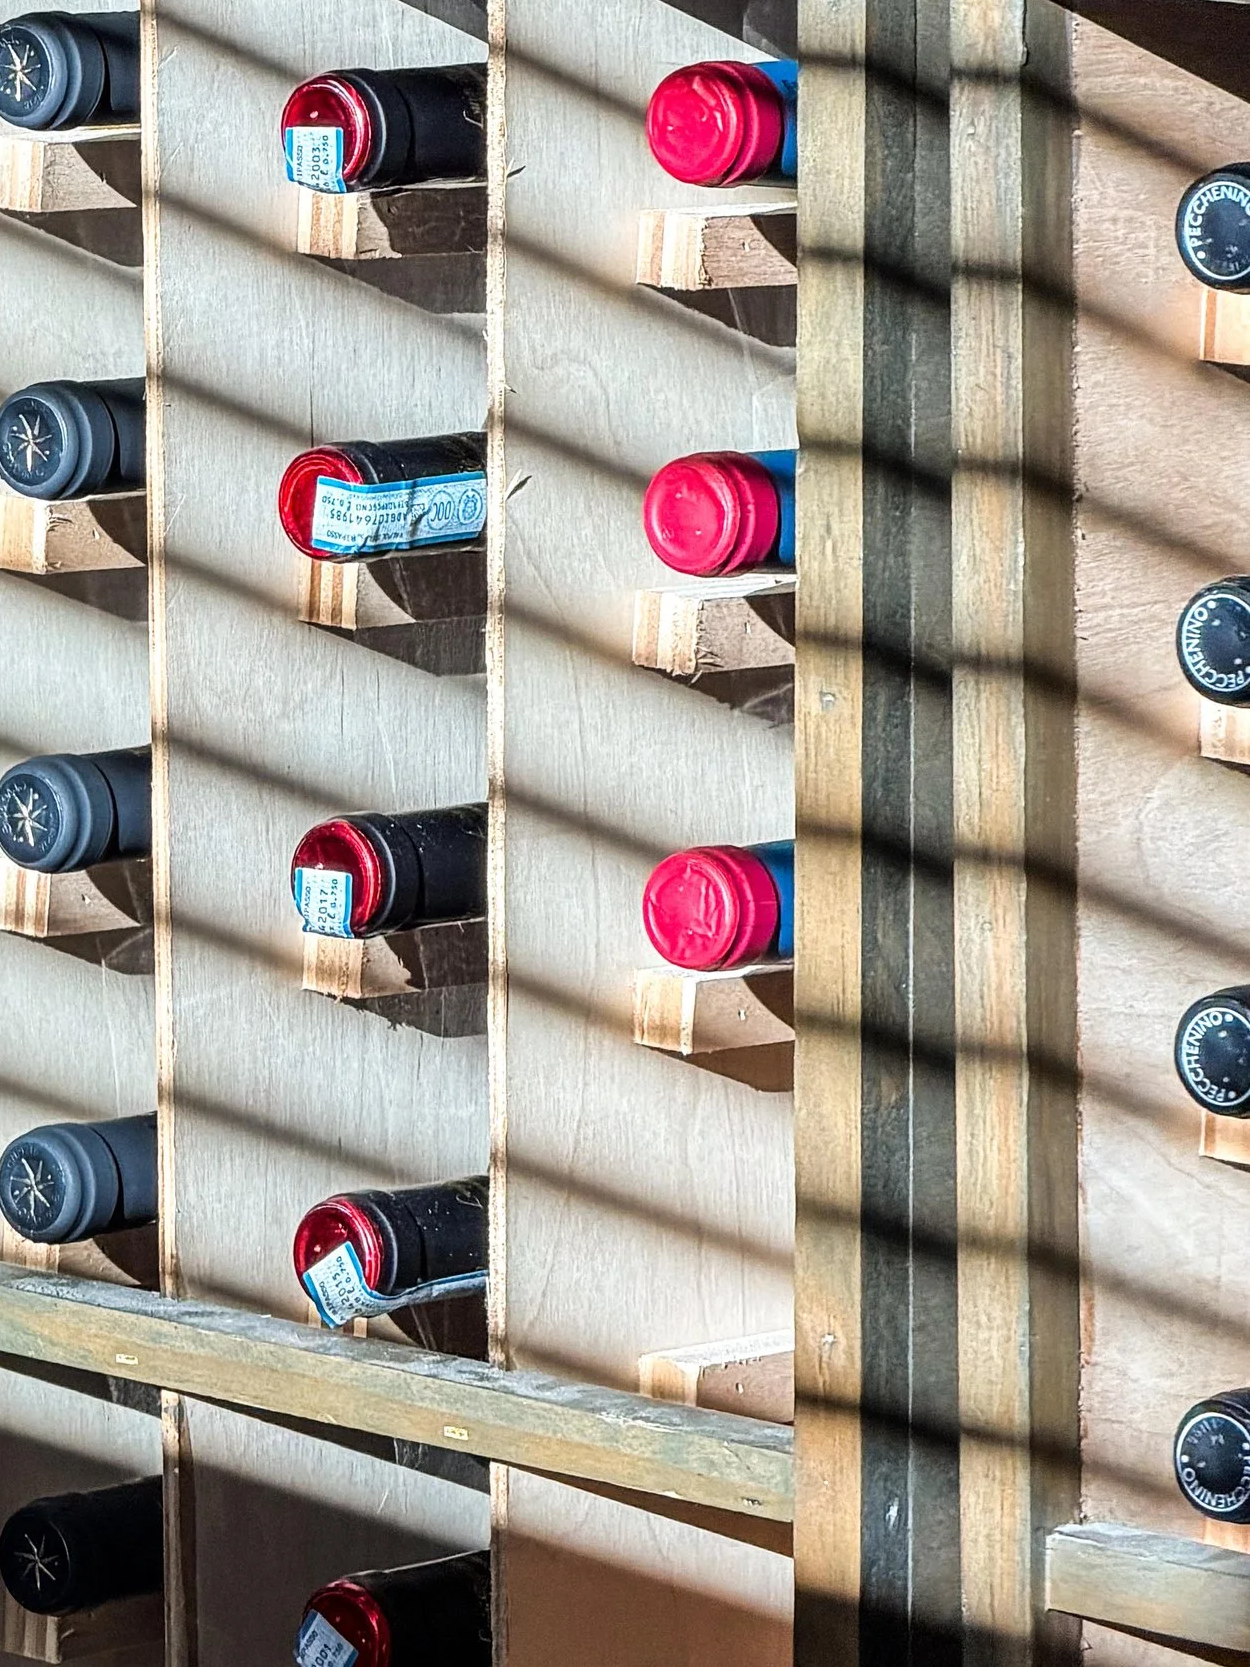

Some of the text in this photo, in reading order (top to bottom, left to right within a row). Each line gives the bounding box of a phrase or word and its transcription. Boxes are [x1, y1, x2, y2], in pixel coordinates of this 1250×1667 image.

[430, 501, 451, 522] DOC
[1186, 607, 1245, 688] PECCHENINO
[1188, 1011, 1226, 1102] PECCHENINO
